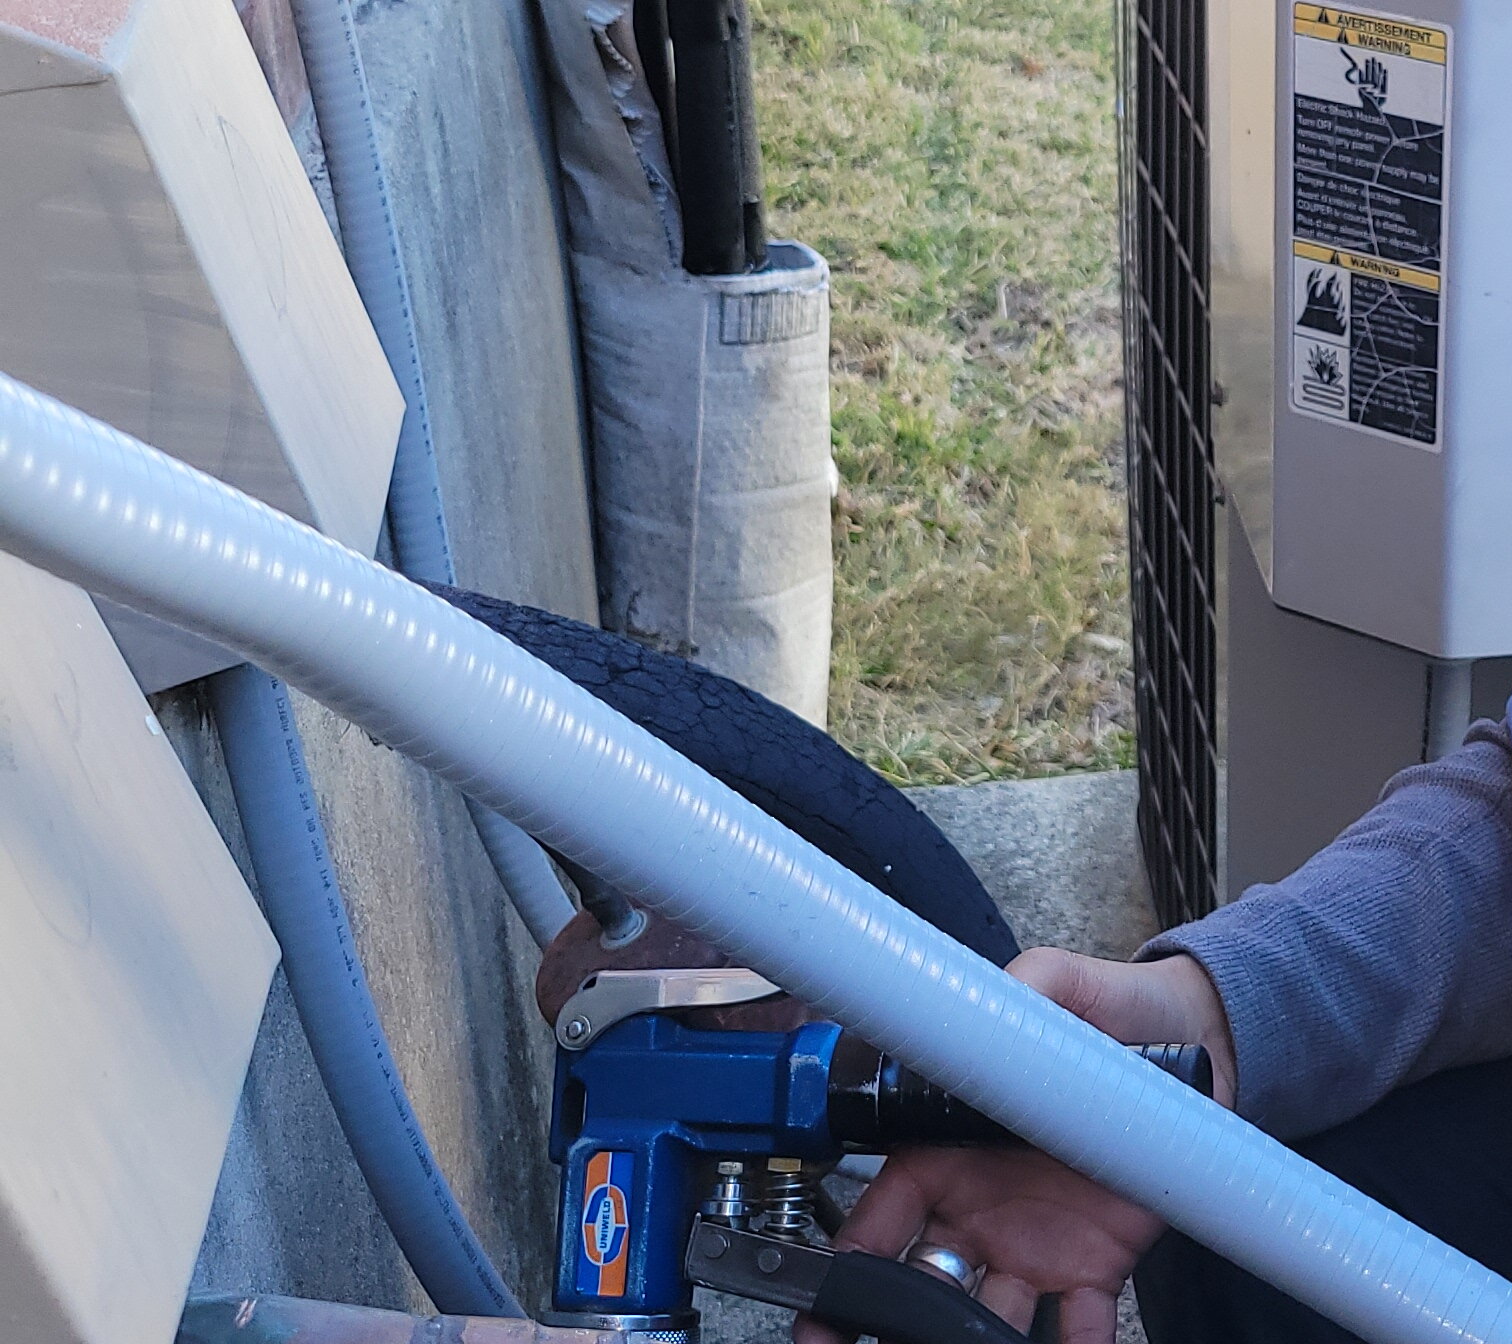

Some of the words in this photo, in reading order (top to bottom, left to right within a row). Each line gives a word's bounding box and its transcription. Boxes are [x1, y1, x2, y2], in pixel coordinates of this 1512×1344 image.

[1337, 14, 1432, 43] AVERTISSEMENT
[1358, 34, 1411, 56] WARNING
[1350, 256, 1400, 277] WARNING
[599, 1200, 611, 1249] UNIWELD
